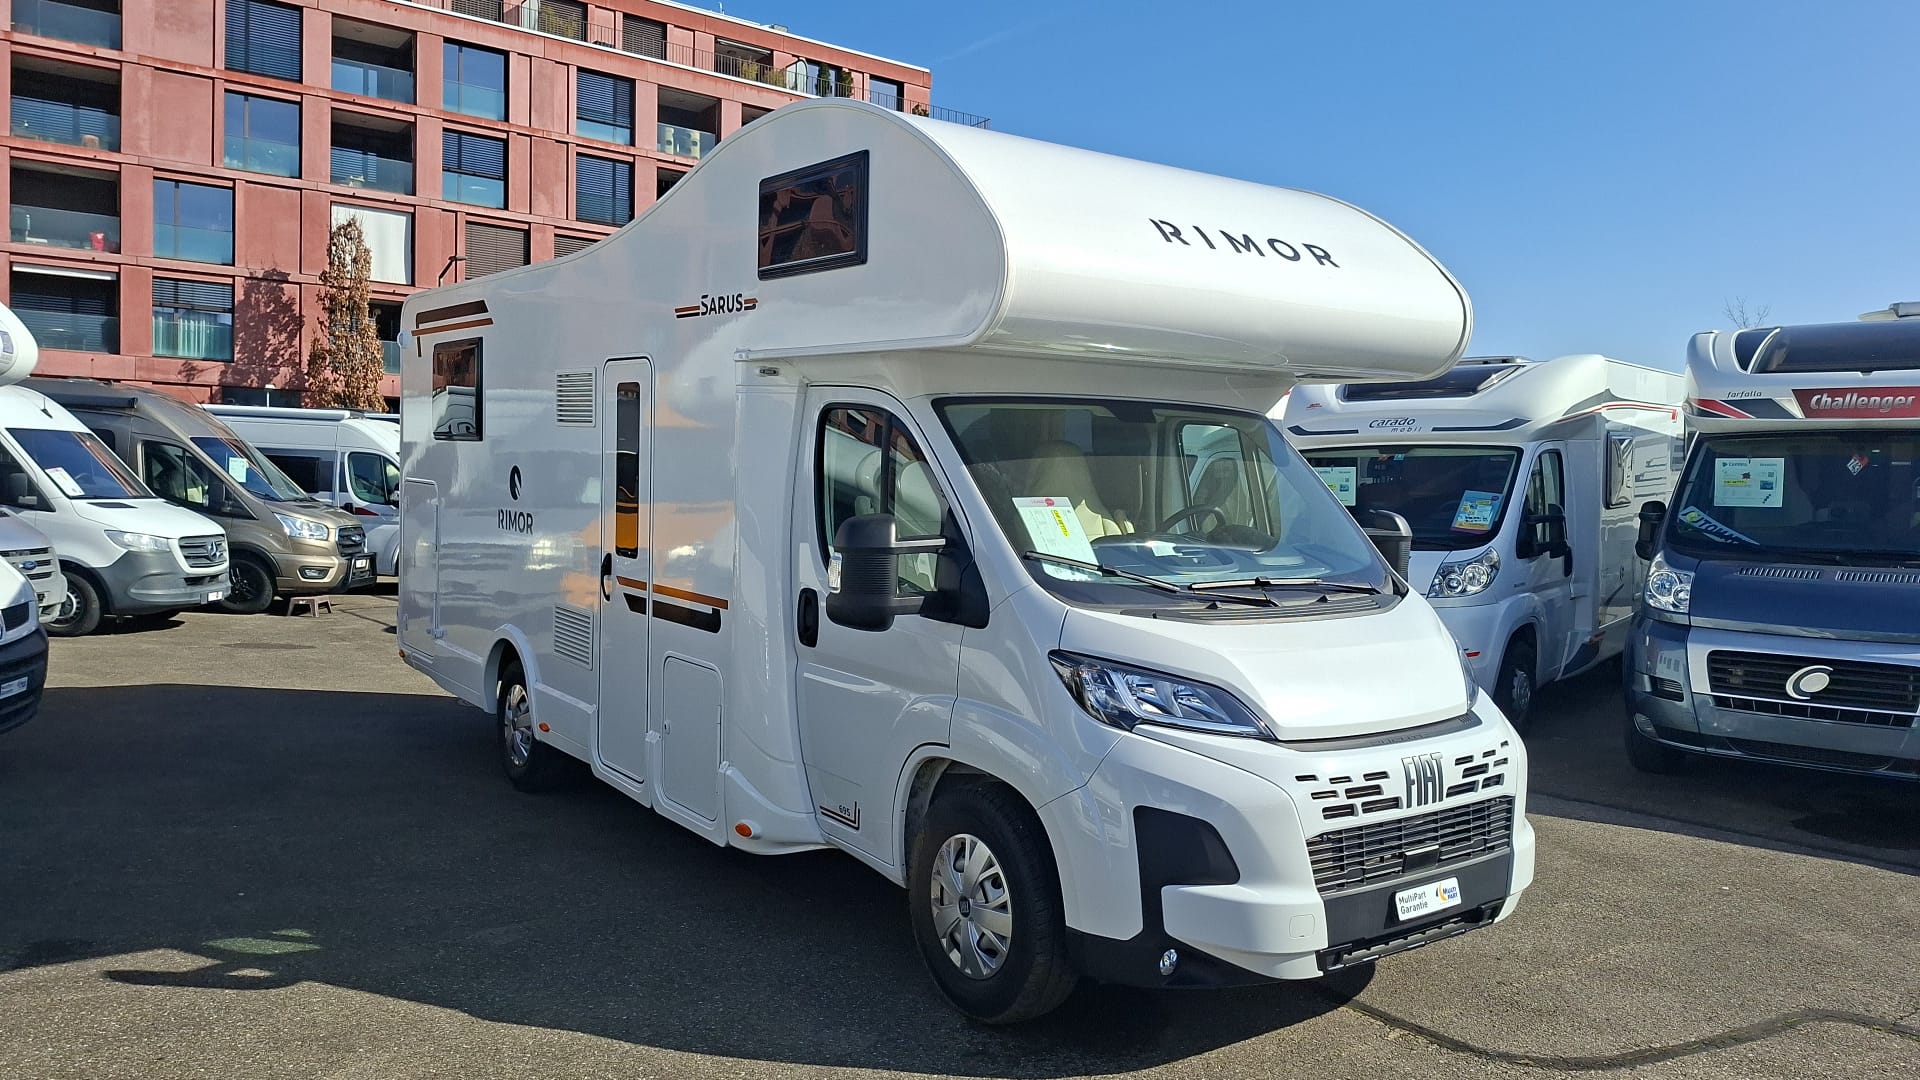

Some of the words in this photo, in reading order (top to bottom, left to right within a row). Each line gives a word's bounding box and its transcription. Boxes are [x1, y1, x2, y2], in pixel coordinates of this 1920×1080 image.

[1149, 218, 1340, 268] RIMOR
[701, 293, 743, 316] SARUS
[1727, 391, 1762, 399] farfalla
[1810, 393, 1916, 413] Challenger
[498, 508, 533, 535] RIMOR
[1401, 752, 1443, 809] FIAT
[839, 804, 850, 817] 695
[1399, 891, 1427, 904] MultiPart
[1400, 901, 1428, 914] Garantie
